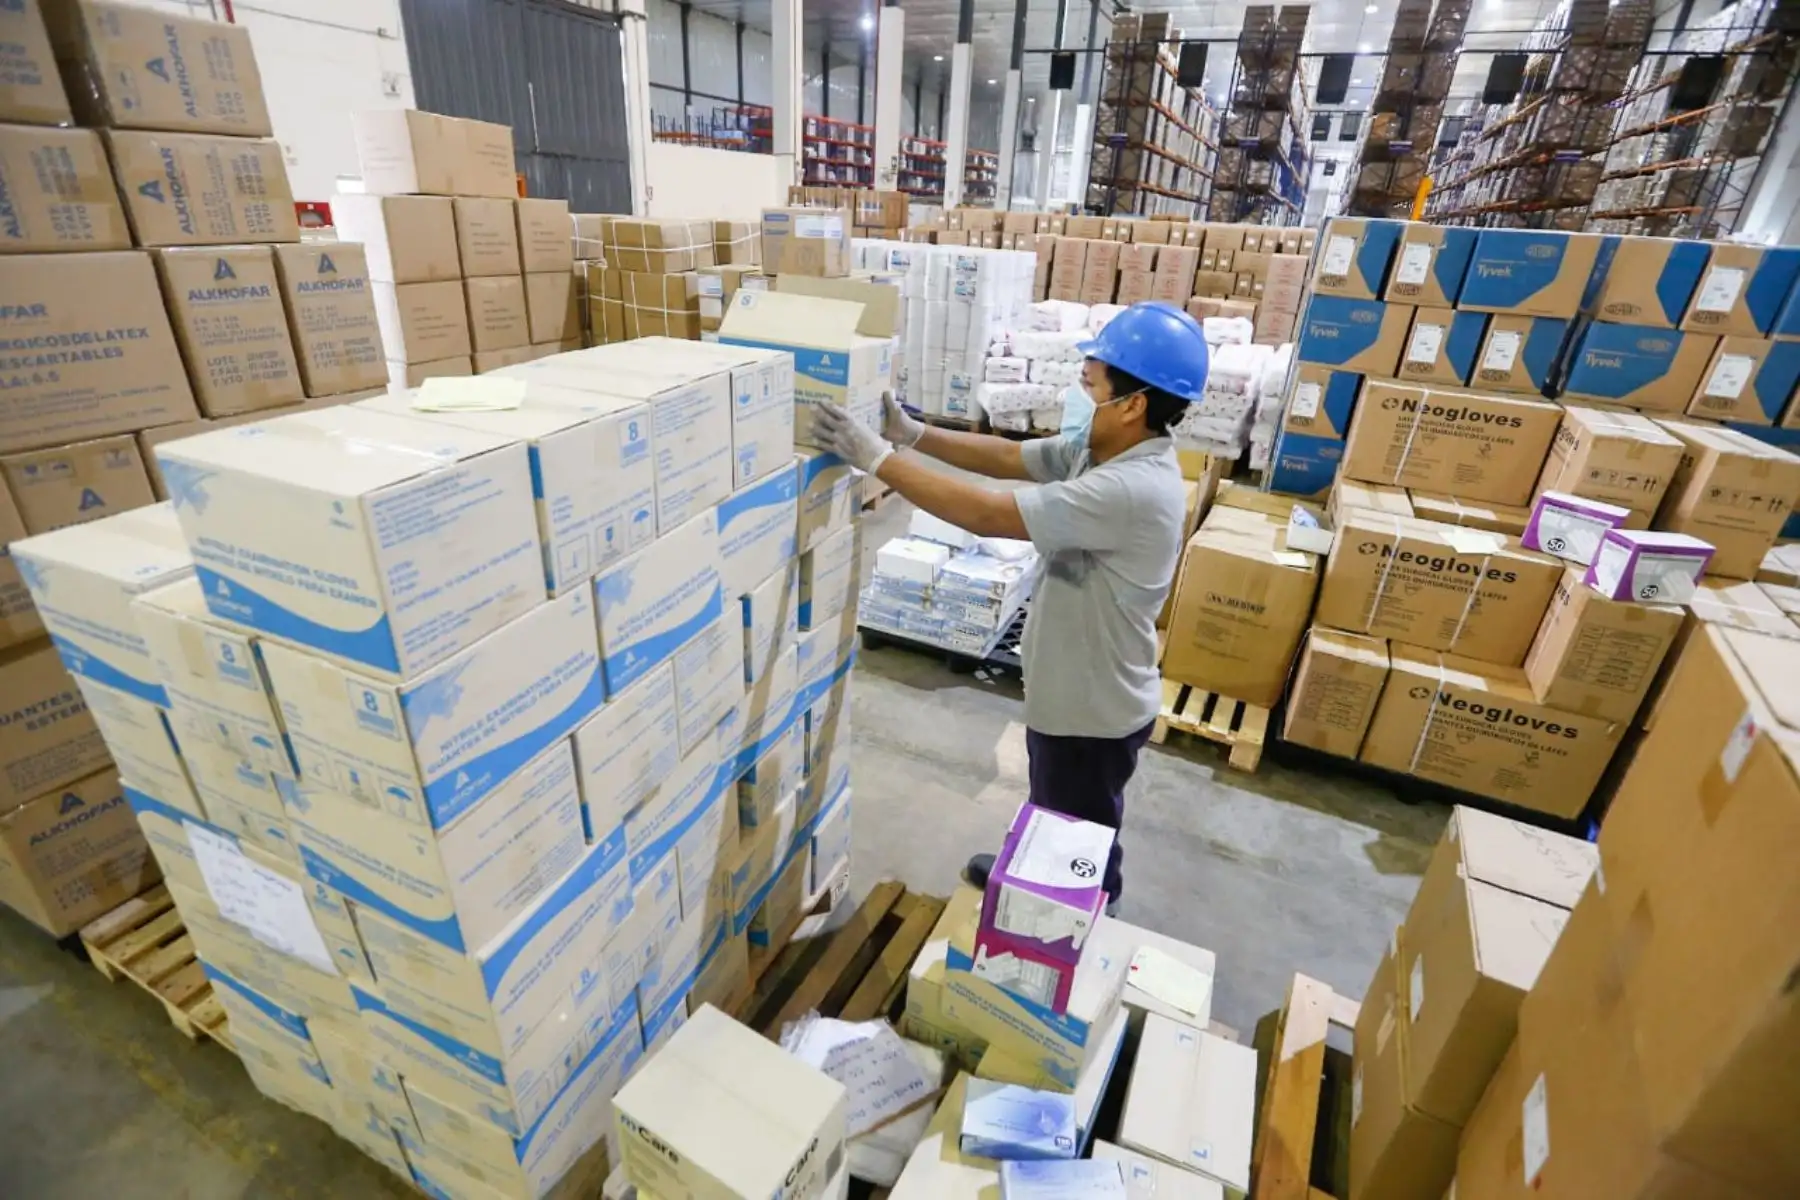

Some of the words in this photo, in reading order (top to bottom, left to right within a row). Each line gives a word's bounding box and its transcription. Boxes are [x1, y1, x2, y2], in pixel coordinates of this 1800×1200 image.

[160, 147, 194, 234] ALKHOFAR
[1476, 264, 1513, 277] Tyvek
[188, 285, 272, 300] ALKHOFAR
[297, 279, 365, 292] ALKHOFAR
[94, 328, 149, 343] LATEX
[1310, 325, 1339, 338] Tyvek
[1585, 353, 1622, 368] Tyvek
[1402, 398, 1523, 428] Neogloves
[1548, 539, 1565, 551] 50
[1381, 544, 1518, 583] Neogloves
[1641, 586, 1657, 598] 50
[1433, 691, 1578, 738] Neogloves
[30, 796, 125, 847] ALKHOFAR
